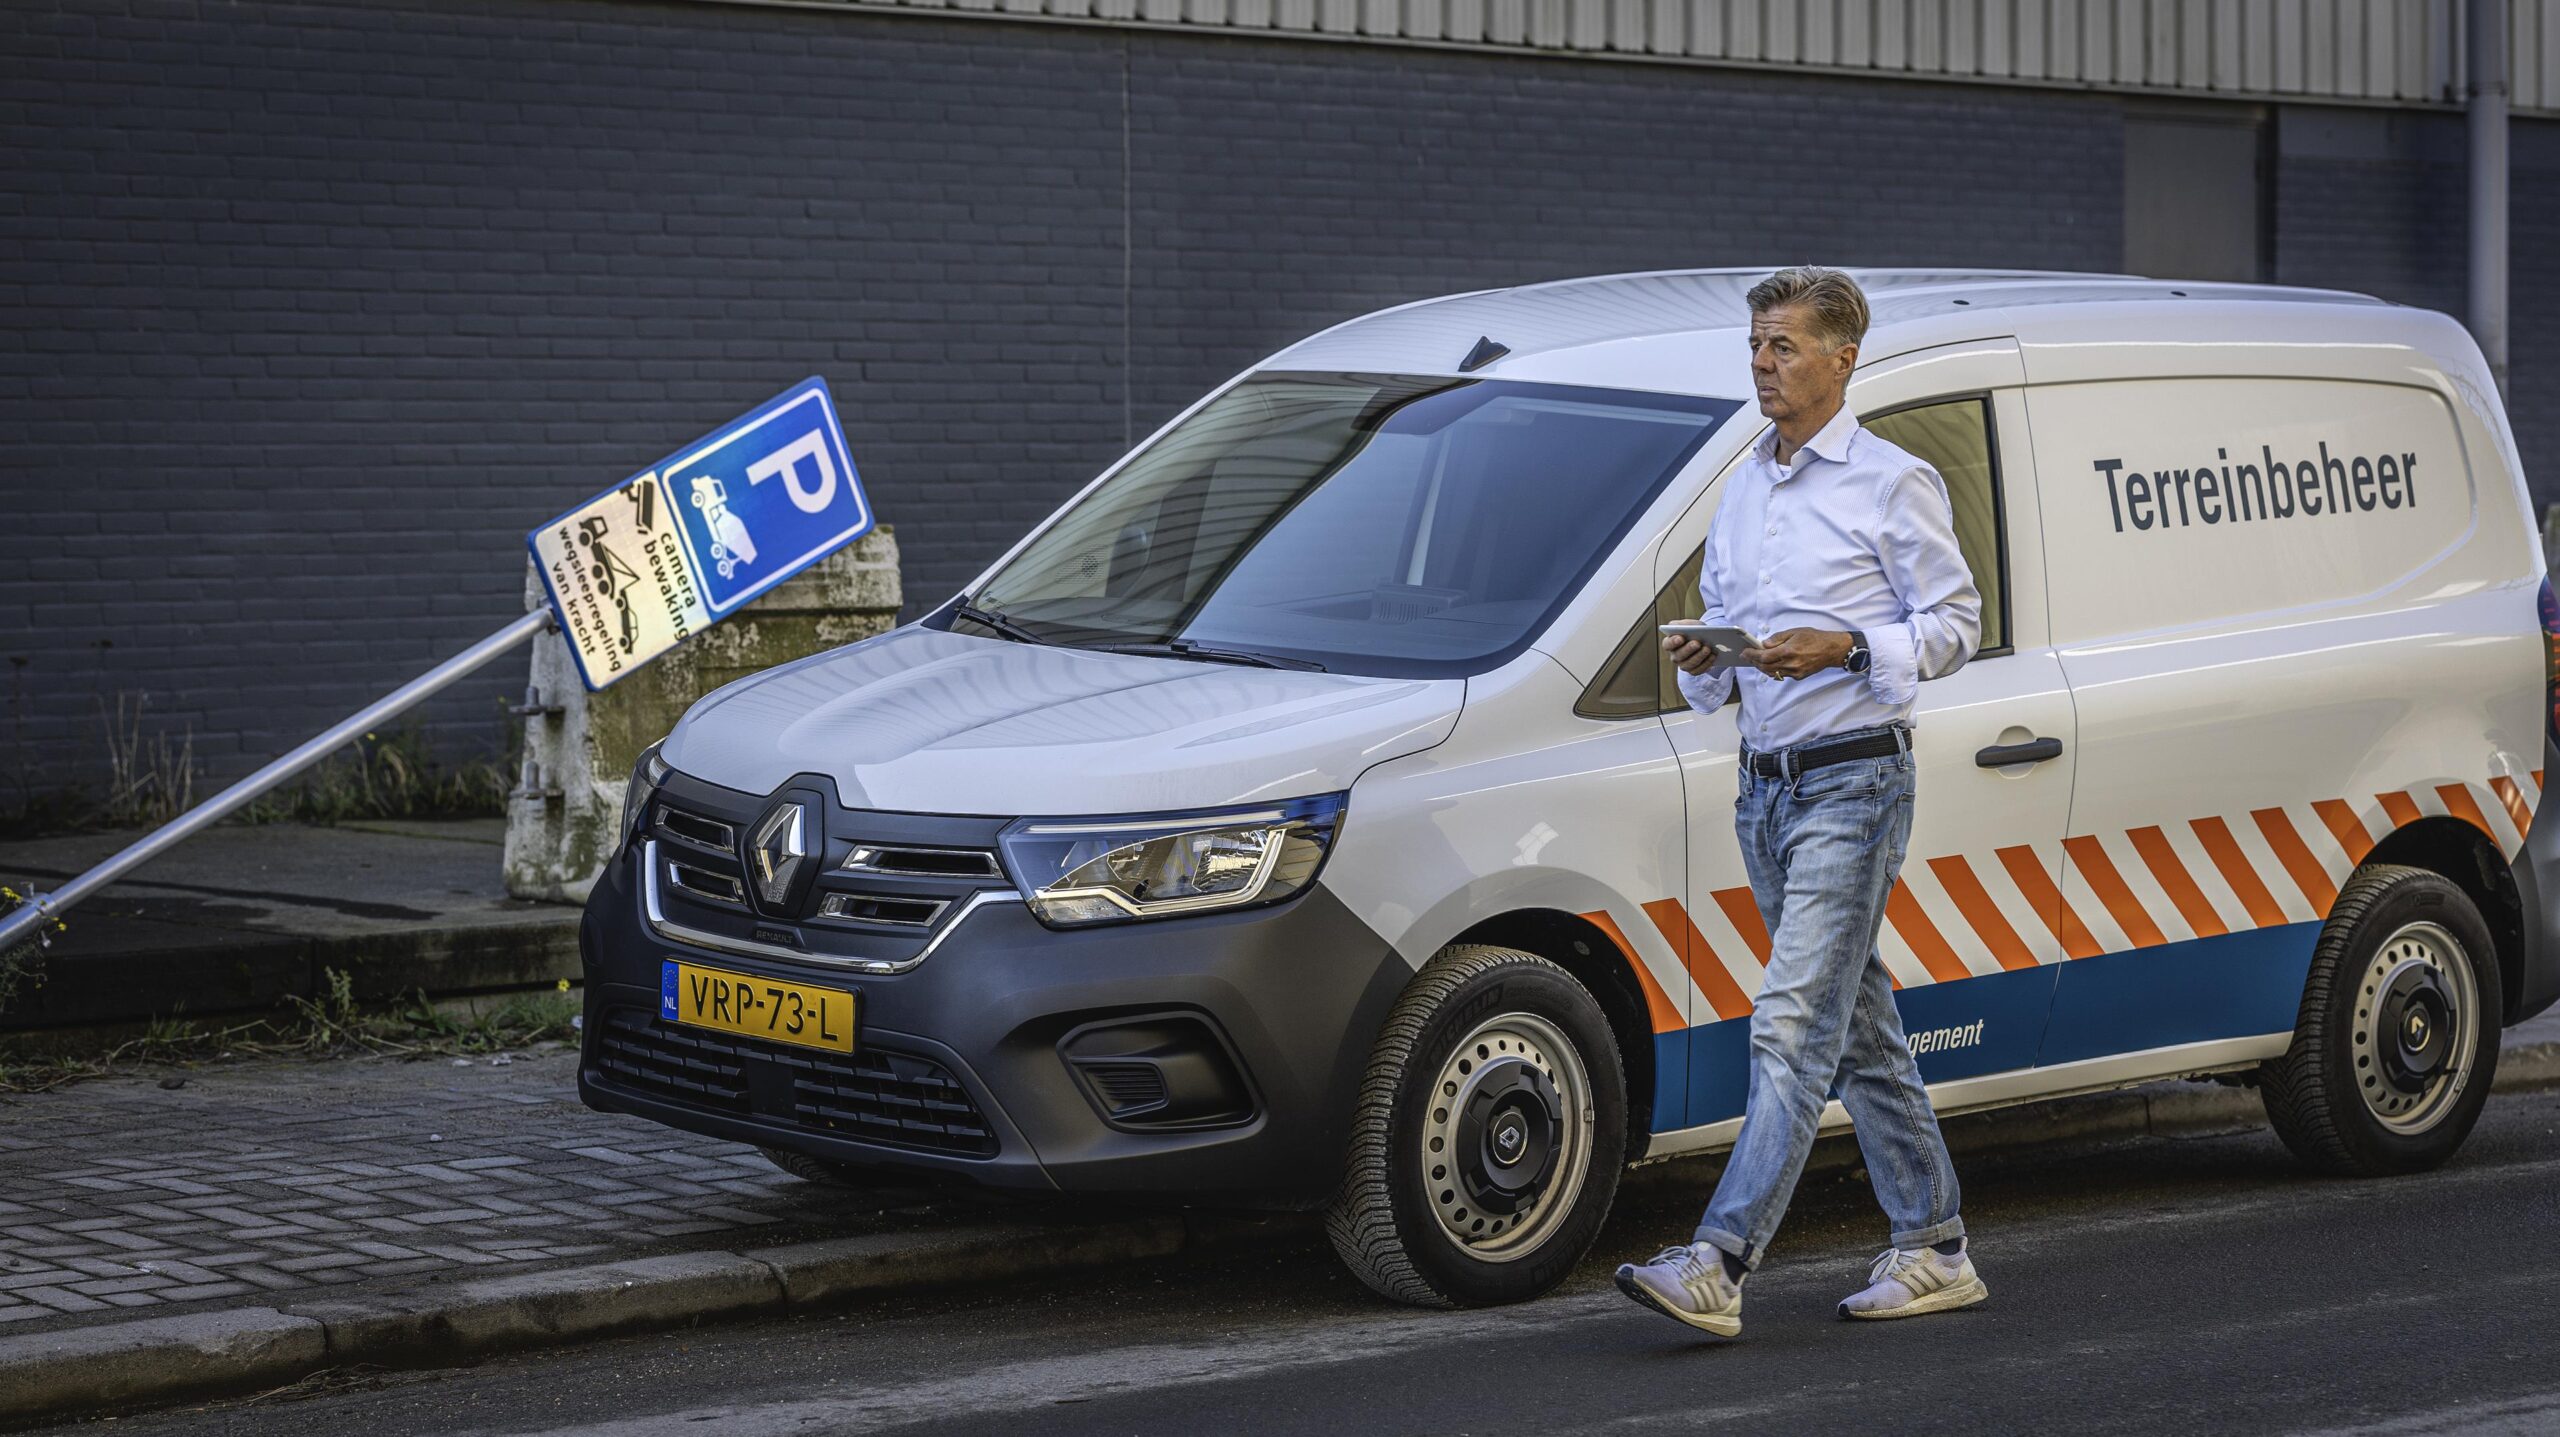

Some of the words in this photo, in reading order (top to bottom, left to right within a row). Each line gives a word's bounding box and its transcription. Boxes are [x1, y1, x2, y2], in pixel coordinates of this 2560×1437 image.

[745, 427, 838, 515] P
[2093, 441, 2417, 533] Terreinbeheer
[552, 562, 571, 595] van
[567, 598, 597, 656] kracht
[559, 527, 622, 672] wegsleepregeling
[643, 539, 690, 642] bewaking
[660, 532, 697, 608] camera
[664, 996, 677, 1011] NL
[690, 974, 838, 1042] VRP-73-L
[1904, 1018, 1985, 1058] gement
